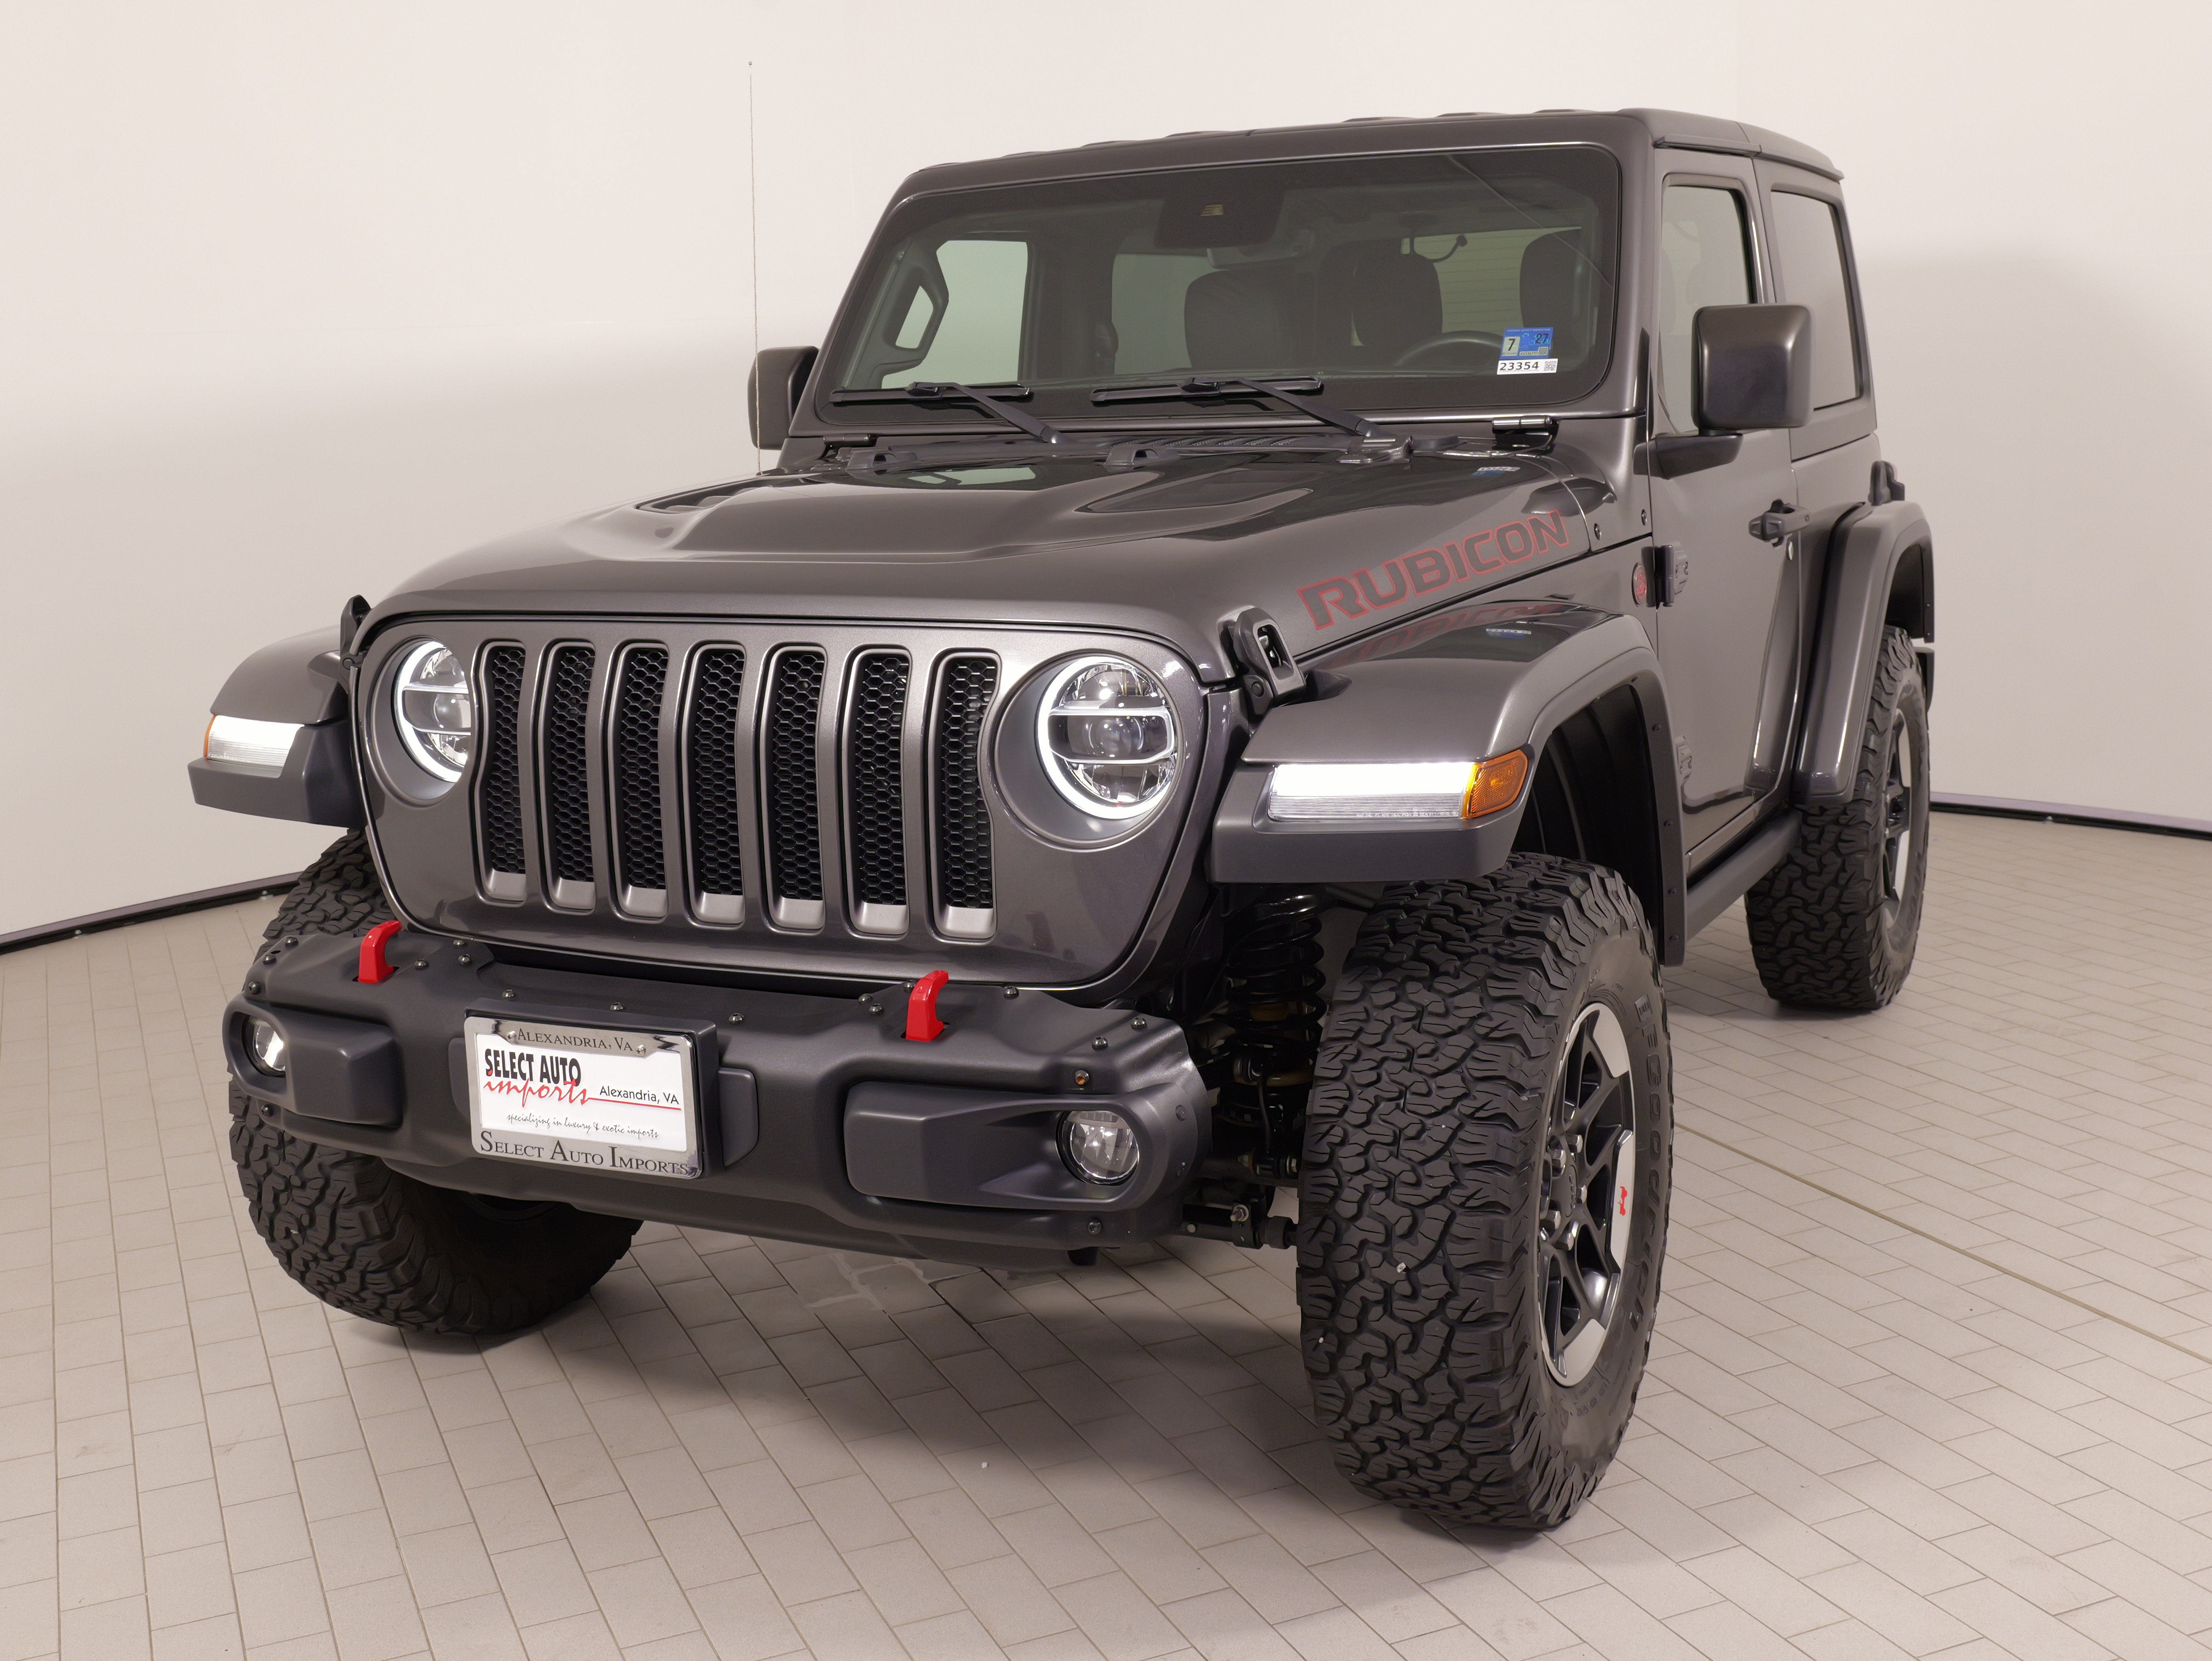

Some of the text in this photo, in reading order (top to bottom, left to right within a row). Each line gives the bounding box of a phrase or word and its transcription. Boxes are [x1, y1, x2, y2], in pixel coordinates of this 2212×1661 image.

[1508, 338, 1516, 351] 7
[1535, 333, 1549, 344] 27
[1500, 361, 1539, 370] 23354
[1297, 509, 1569, 631] RUBICON
[518, 1028, 612, 1050] ALEXANDRIA,
[485, 1049, 581, 1087] SELECT AUTO
[484, 1078, 590, 1107] imports
[599, 1085, 680, 1105] Alexandria, VA
[507, 1112, 551, 1129] specializing
[564, 1117, 591, 1133] luxury
[593, 1122, 600, 1132] &
[602, 1123, 624, 1134] exotic
[627, 1127, 659, 1139] imports
[480, 1131, 688, 1176] SELECT AUTO IMPORTS
[1629, 994, 1661, 1332] BFGoodrich
